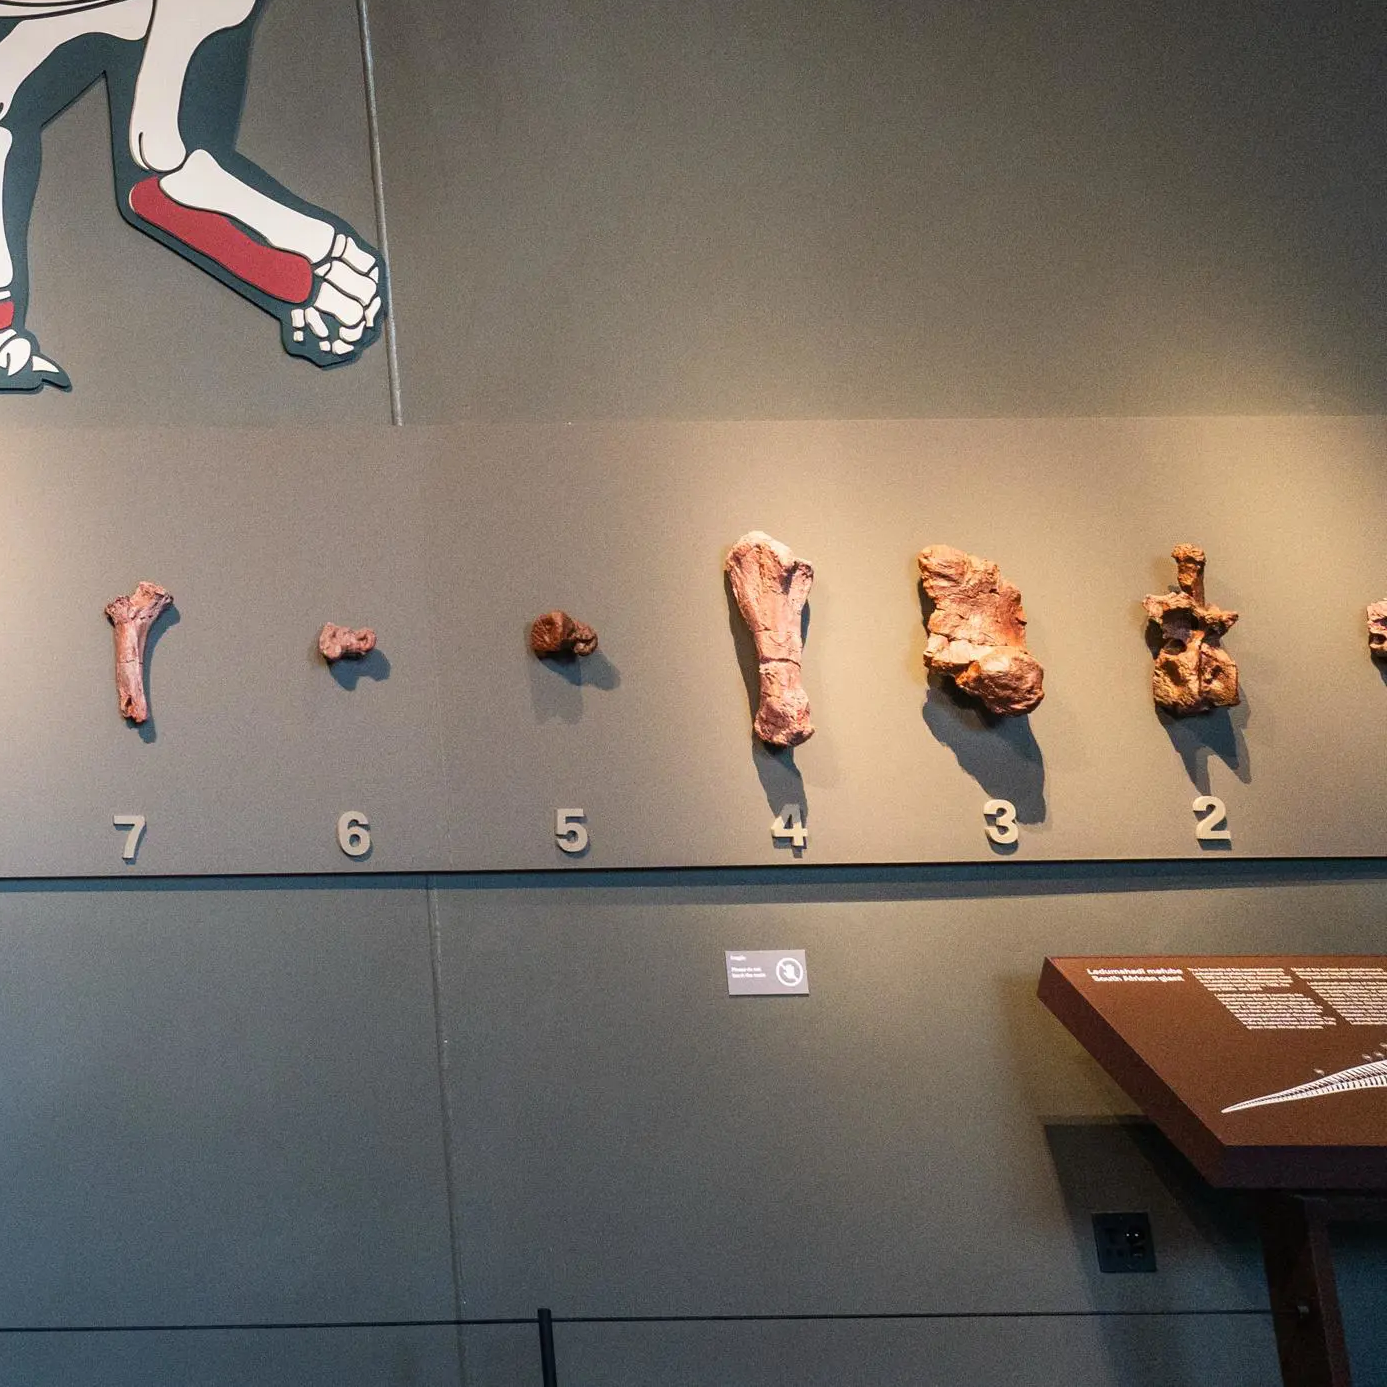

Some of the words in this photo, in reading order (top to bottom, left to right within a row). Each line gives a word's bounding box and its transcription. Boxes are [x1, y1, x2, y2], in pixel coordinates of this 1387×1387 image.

[113, 815, 146, 859] 7
[337, 810, 371, 856] 6
[555, 808, 588, 852] 5
[770, 804, 808, 846] 4
[984, 798, 1019, 844] 3
[1192, 795, 1231, 840] 2
